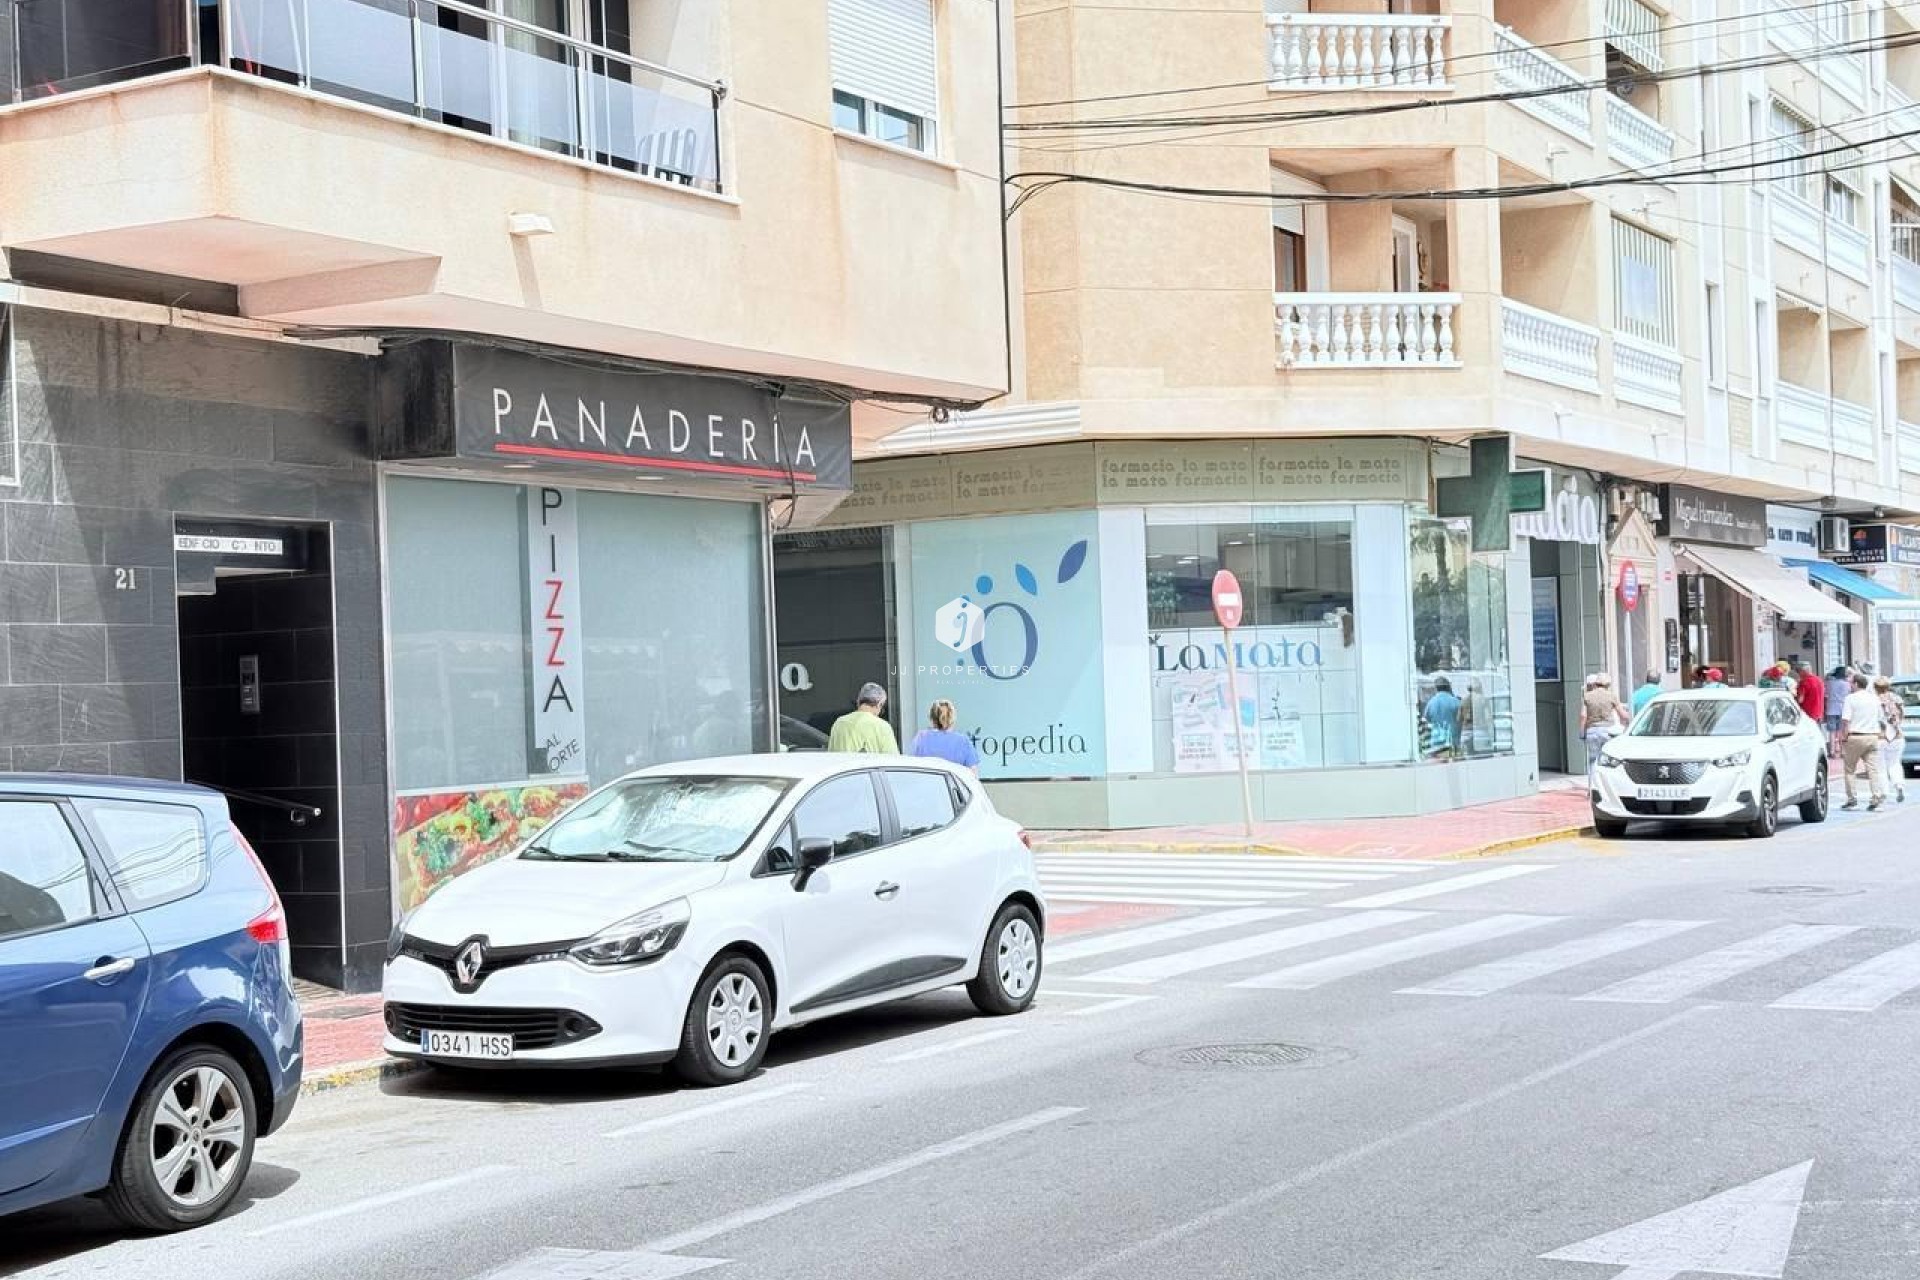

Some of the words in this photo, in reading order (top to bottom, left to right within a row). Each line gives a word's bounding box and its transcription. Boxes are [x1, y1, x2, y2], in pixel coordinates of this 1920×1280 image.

[1259, 457, 1329, 471] farmacia
[115, 567, 136, 590] 21
[541, 487, 573, 712] PIZZA
[549, 739, 581, 772] ORTE
[432, 1033, 471, 1052] 0341
[481, 1036, 510, 1056] HSS
